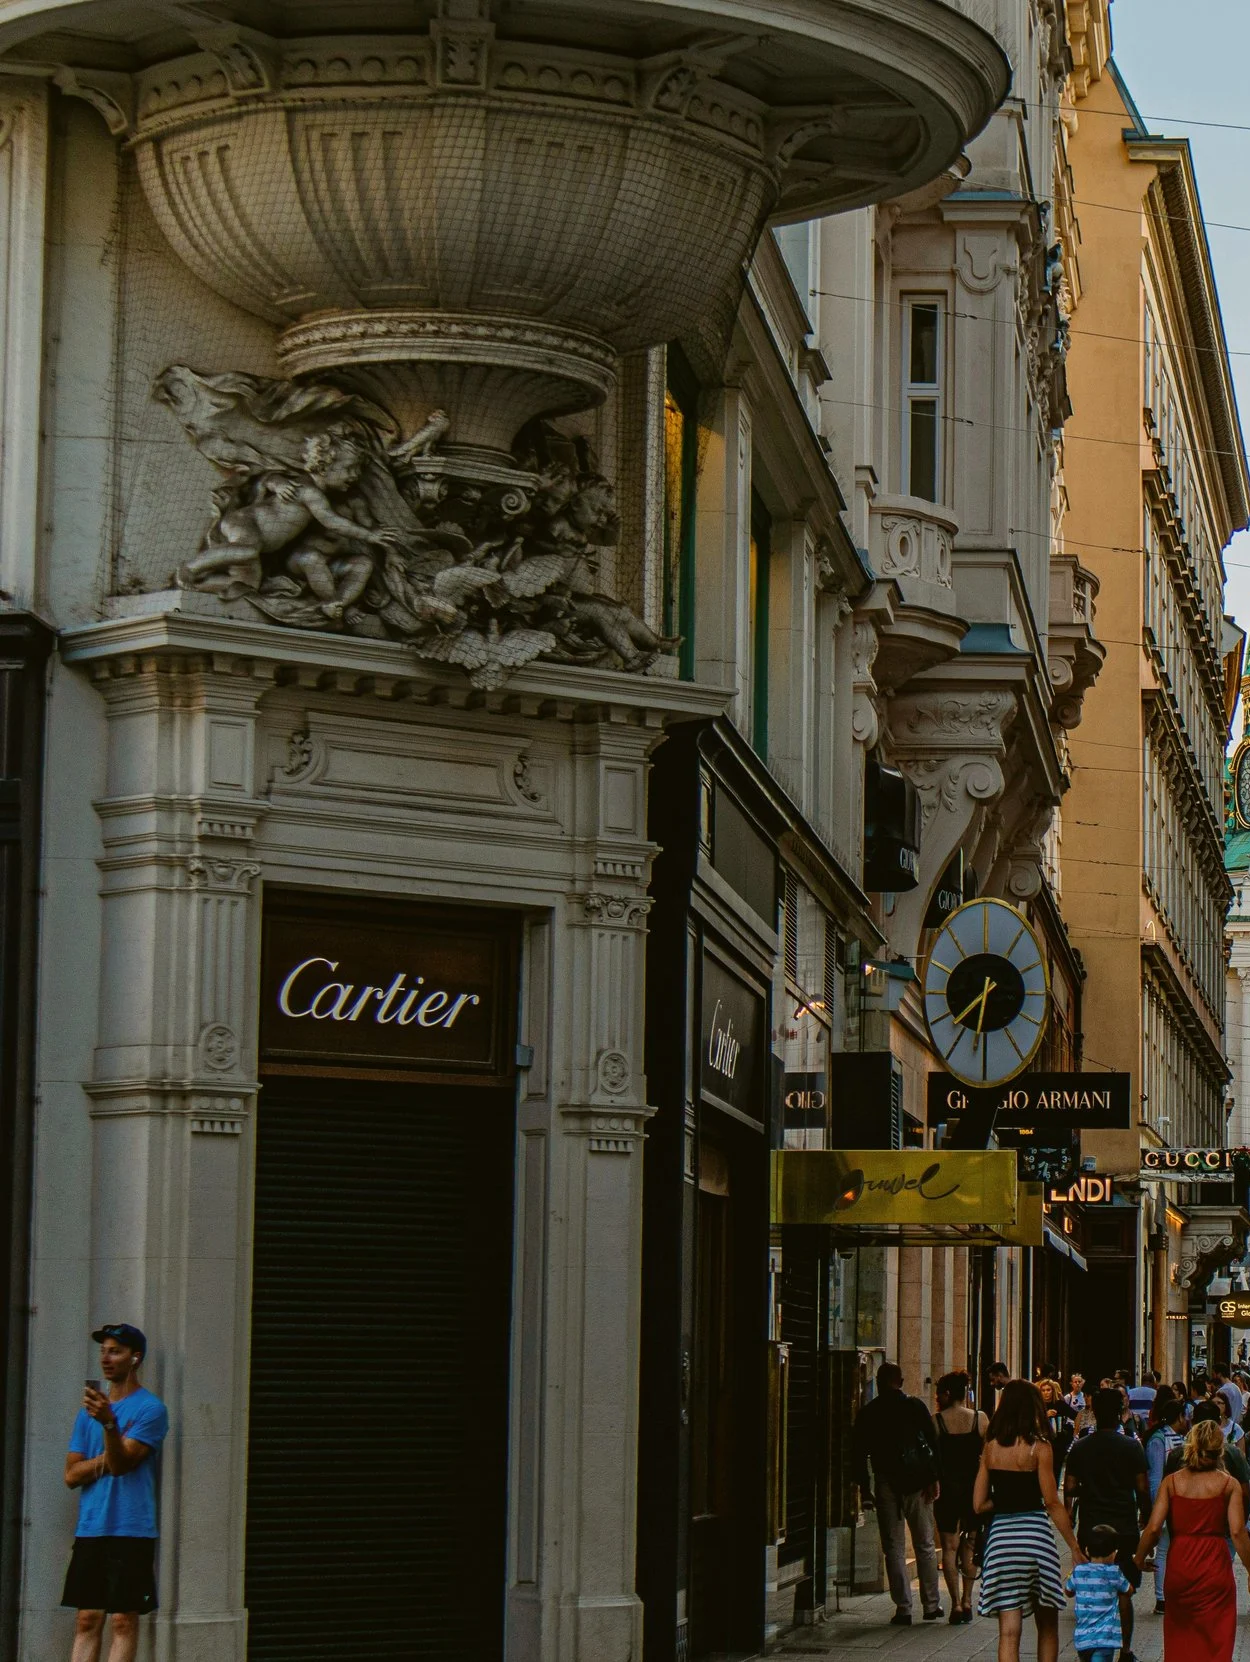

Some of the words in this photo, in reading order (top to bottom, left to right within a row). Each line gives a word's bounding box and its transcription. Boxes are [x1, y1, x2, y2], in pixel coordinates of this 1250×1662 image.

[278, 957, 480, 1029] Cartier
[709, 999, 740, 1079] Cartier
[1036, 1091, 1111, 1110] ARMANI
[1145, 1152, 1231, 1167] GUCCI
[1220, 1301, 1236, 1313] GS
